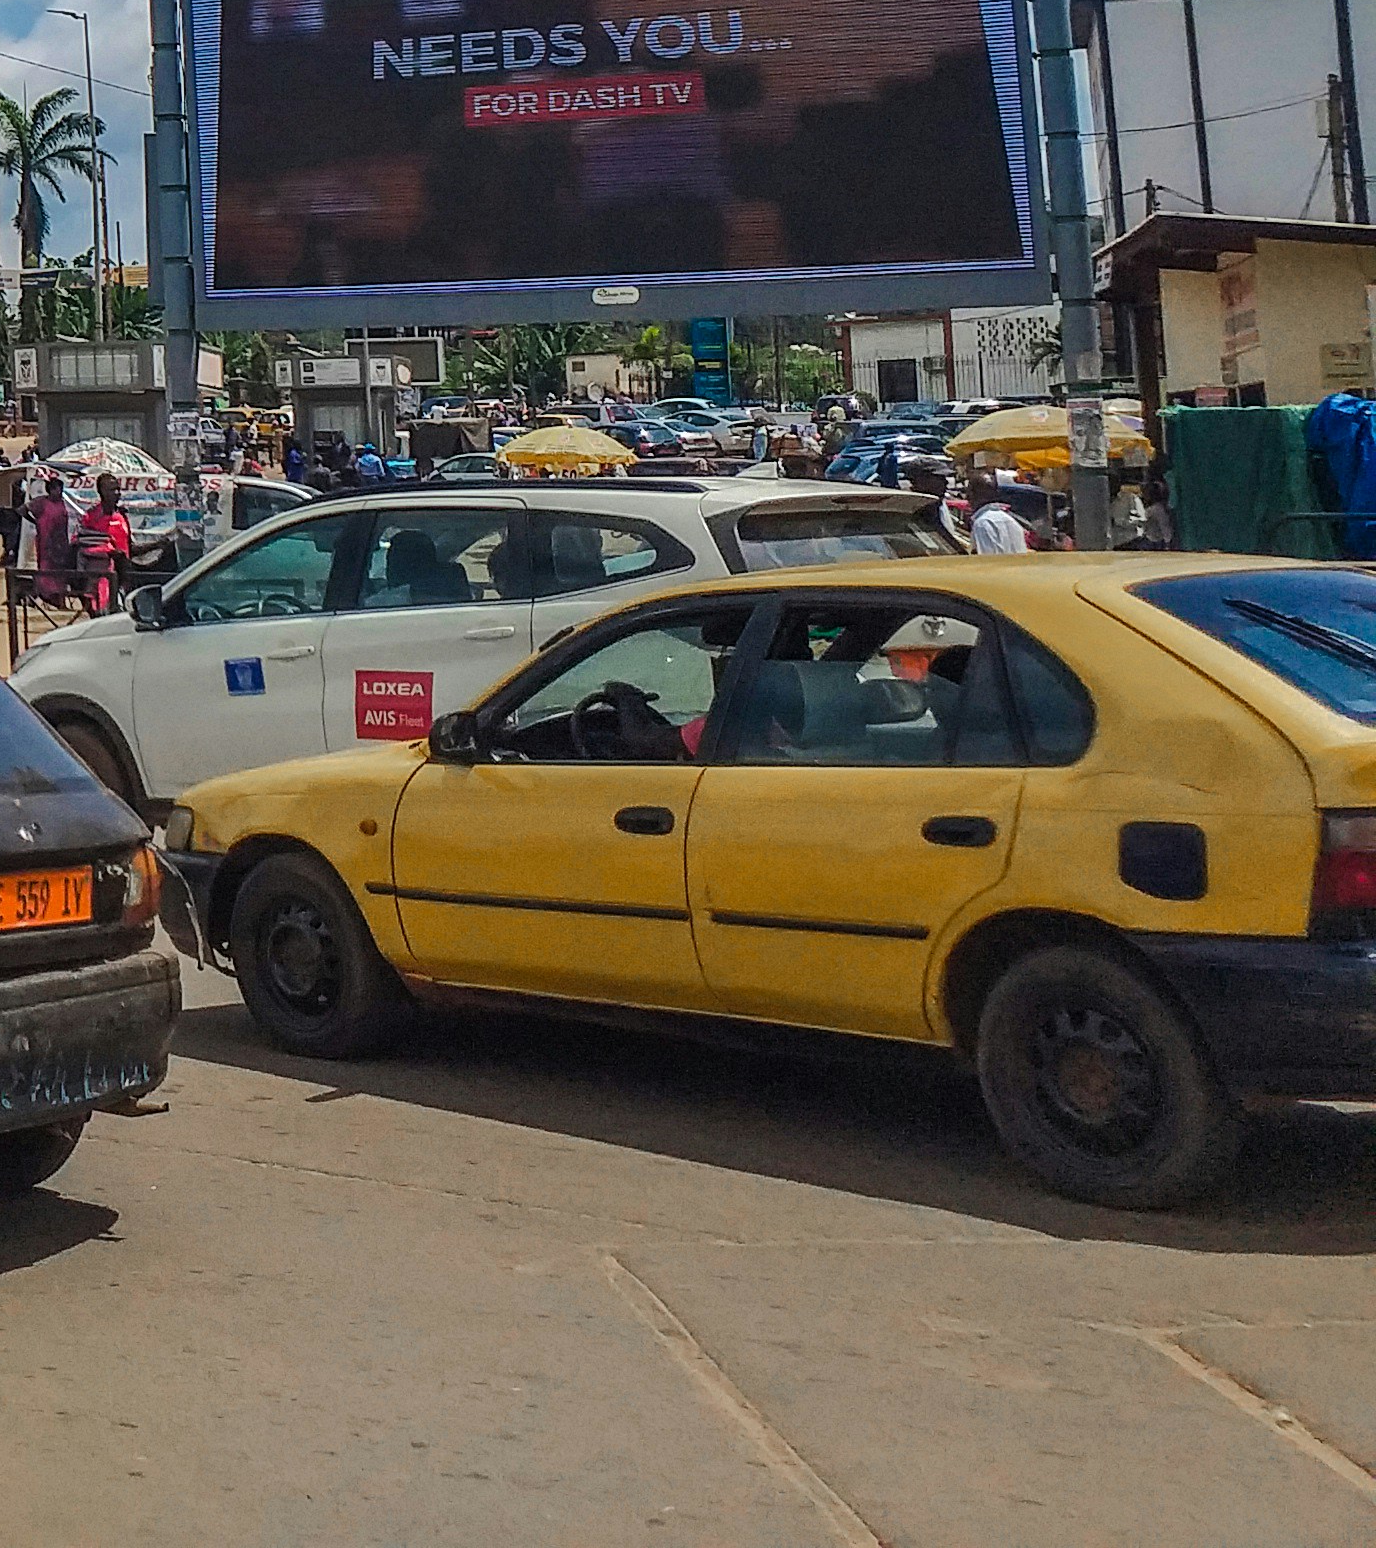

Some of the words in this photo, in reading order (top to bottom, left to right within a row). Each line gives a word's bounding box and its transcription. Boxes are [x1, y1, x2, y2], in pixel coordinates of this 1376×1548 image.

[372, 23, 588, 81] NEEDS
[599, 9, 794, 64] YOU...
[472, 92, 540, 119] FOR
[548, 85, 642, 114] DASH
[653, 81, 693, 106] TV
[363, 682, 425, 697] LOXEA
[364, 710, 396, 727] AVIS
[399, 714, 424, 727] Fleet
[16, 879, 50, 919] 559
